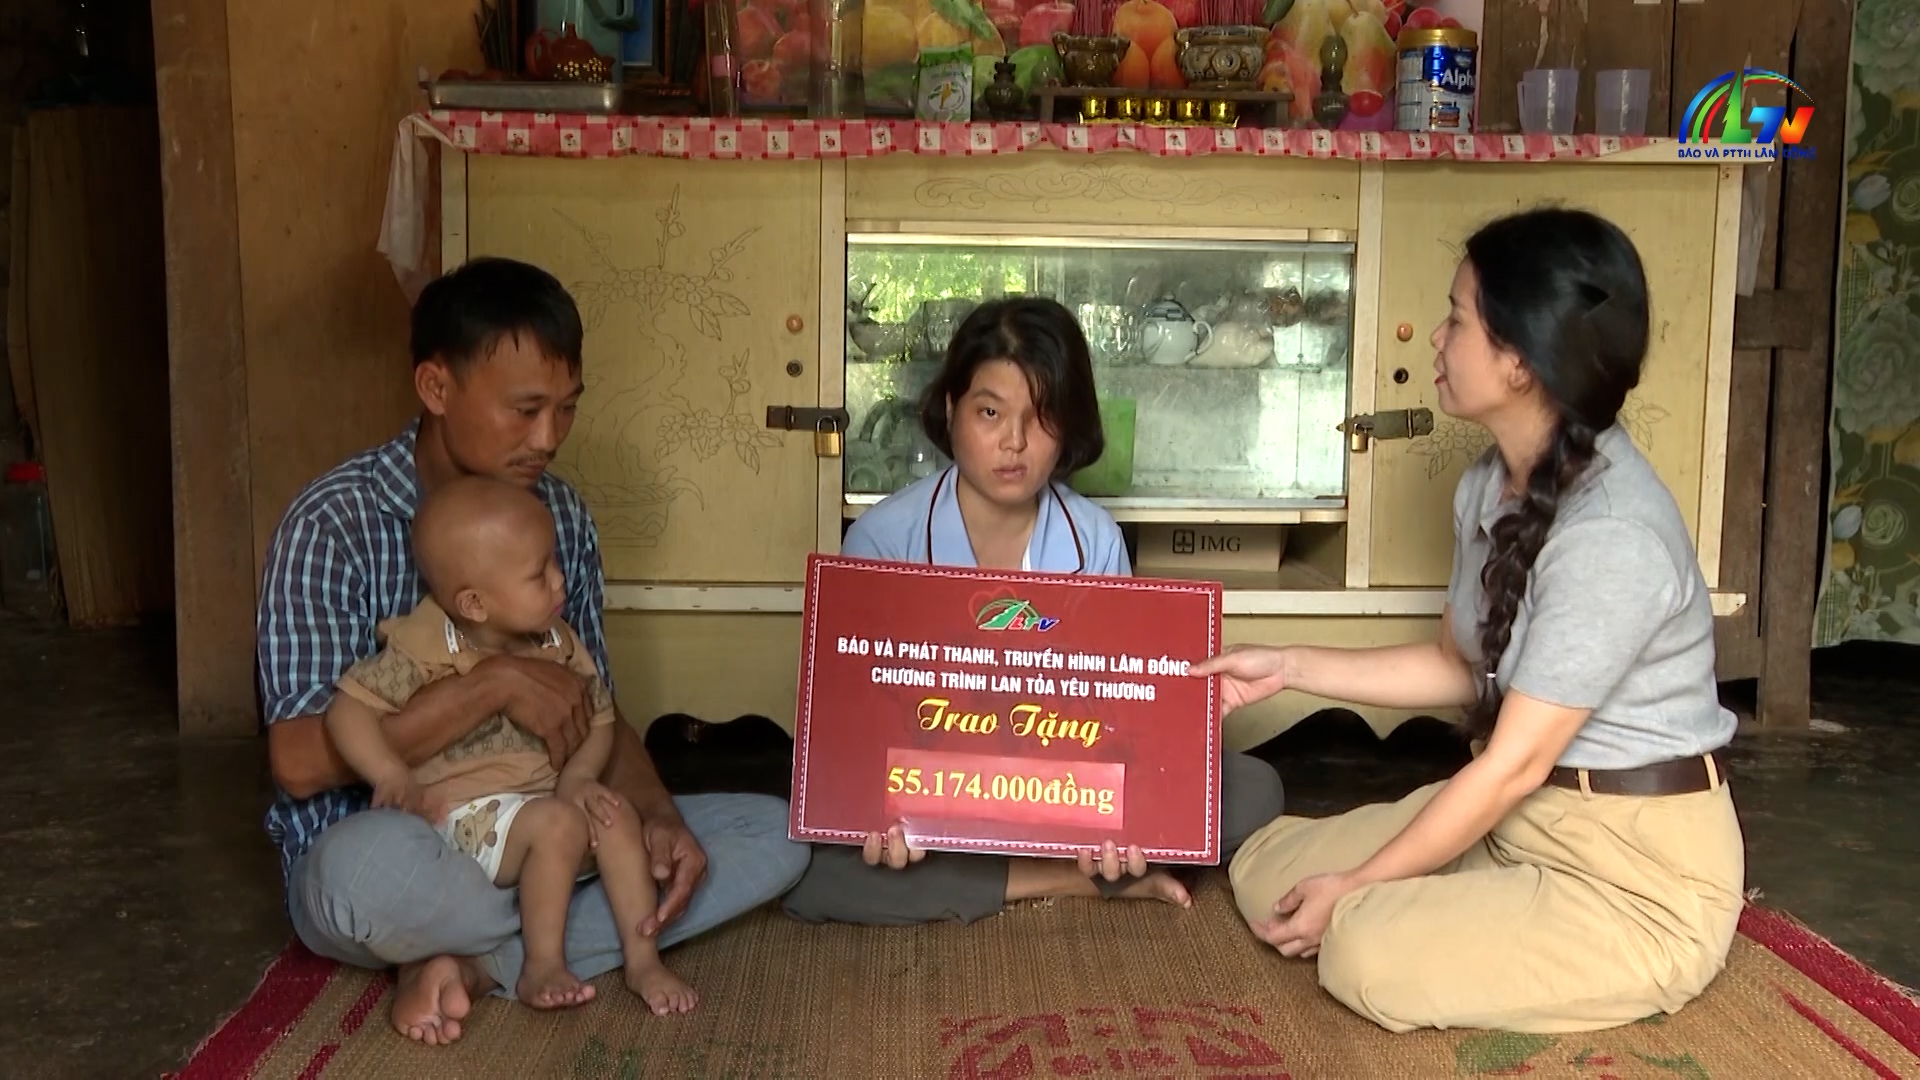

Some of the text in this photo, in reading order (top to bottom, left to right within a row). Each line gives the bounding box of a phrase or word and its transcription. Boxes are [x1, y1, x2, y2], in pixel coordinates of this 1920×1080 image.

[1200, 535, 1241, 552] IMG
[1008, 616, 1061, 632] LTV
[837, 635, 870, 656] BÁO
[873, 637, 894, 658] VÀ
[898, 641, 939, 661] PHÁT
[943, 645, 999, 667] THANH,
[1067, 651, 1106, 672] HÌNH
[1110, 653, 1143, 674] LÂM
[871, 667, 1156, 701] CHƯƠNG TRÌNH LAN TỎA YÊU THƯƠNG
[917, 698, 1102, 748] Trao Tặng
[887, 766, 1115, 815] 55.174.000đồng
